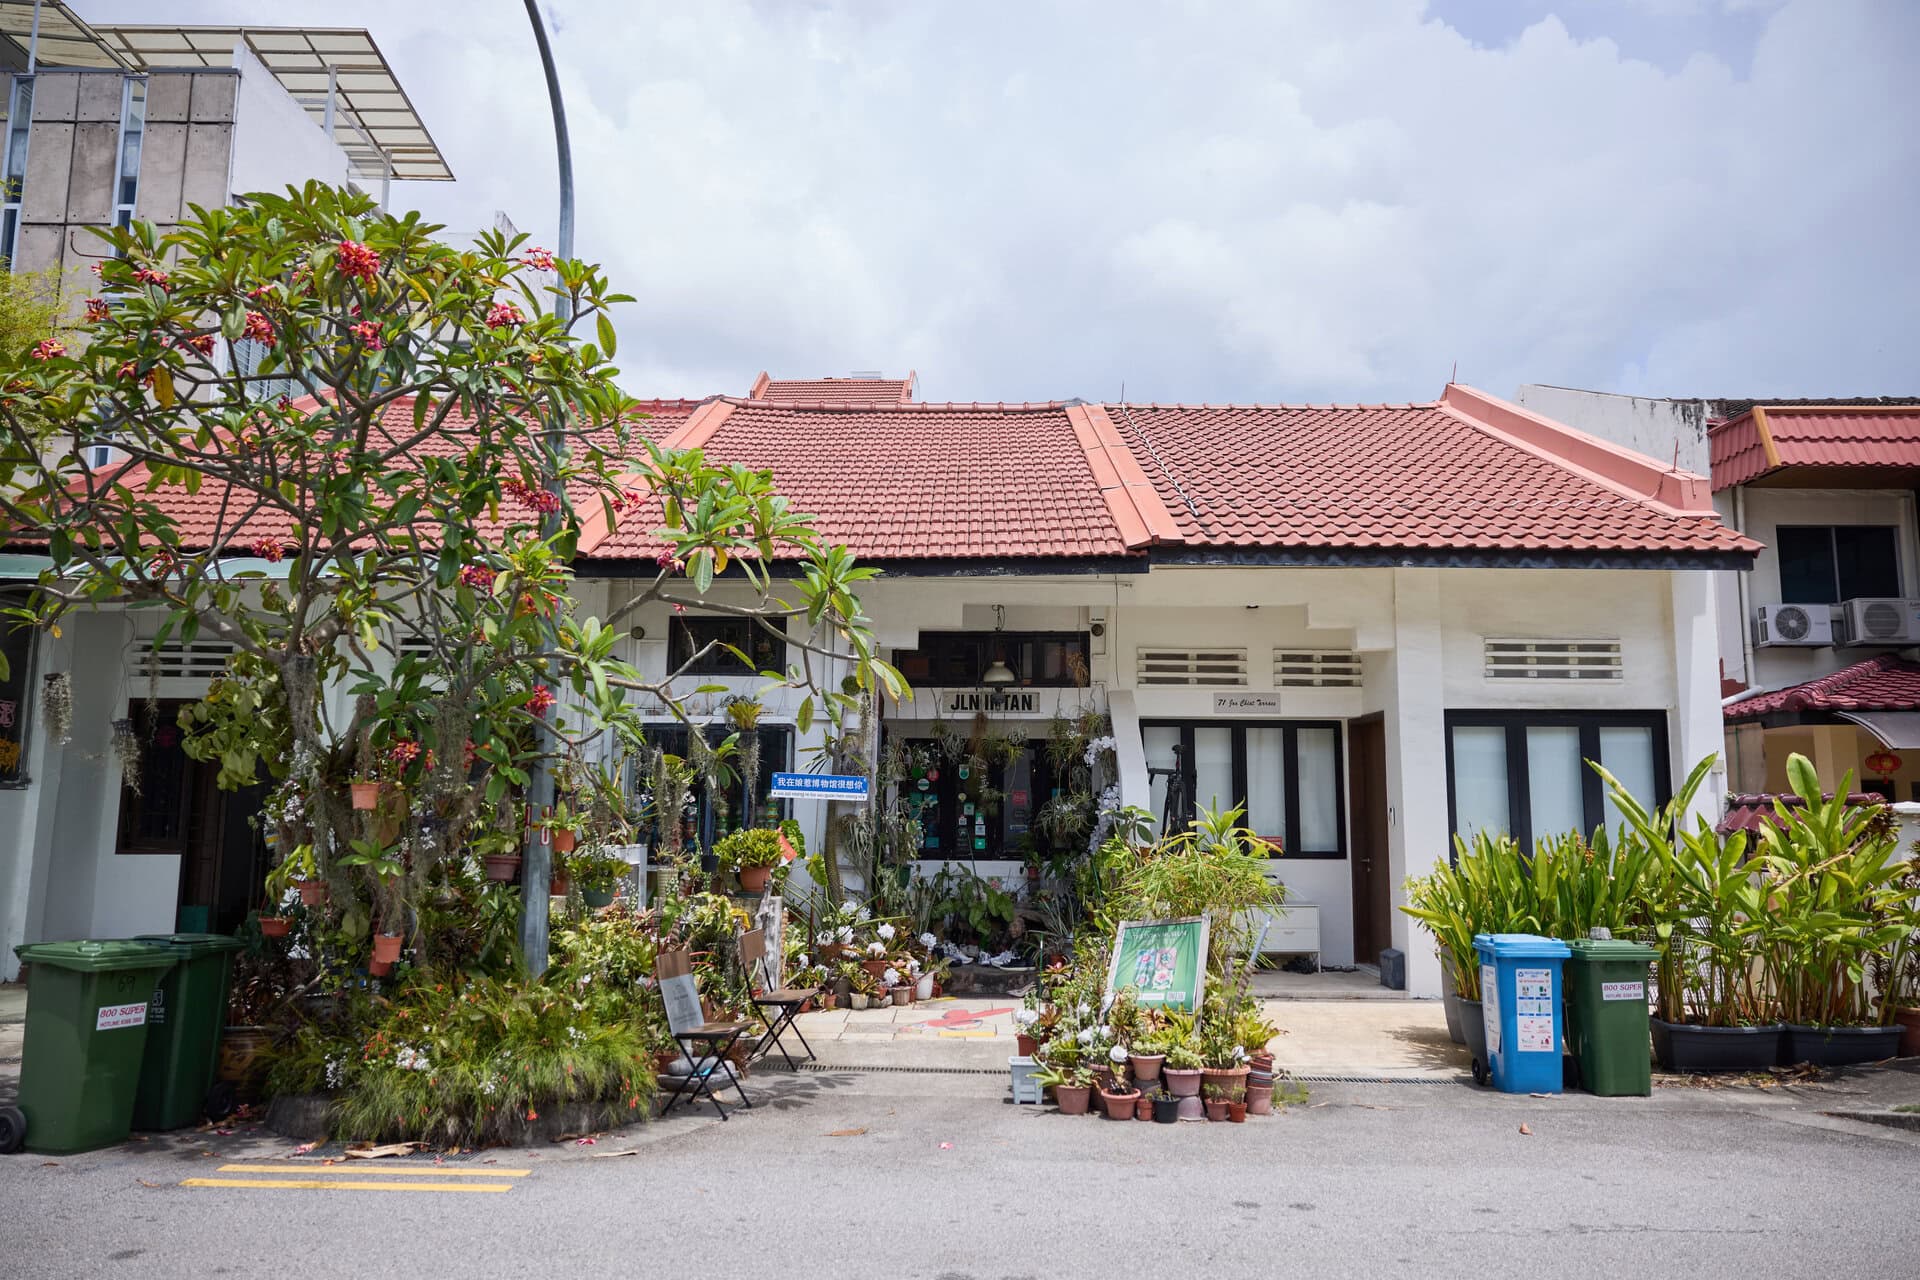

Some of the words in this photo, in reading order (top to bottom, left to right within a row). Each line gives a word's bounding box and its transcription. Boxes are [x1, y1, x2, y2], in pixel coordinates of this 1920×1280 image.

[951, 694, 980, 711] JLN
[1217, 698, 1226, 706] 71
[1239, 698, 1255, 707] Chiat
[1256, 698, 1276, 706] Terrace
[1619, 983, 1643, 991] SUPER
[119, 1004, 146, 1016] SUPER
